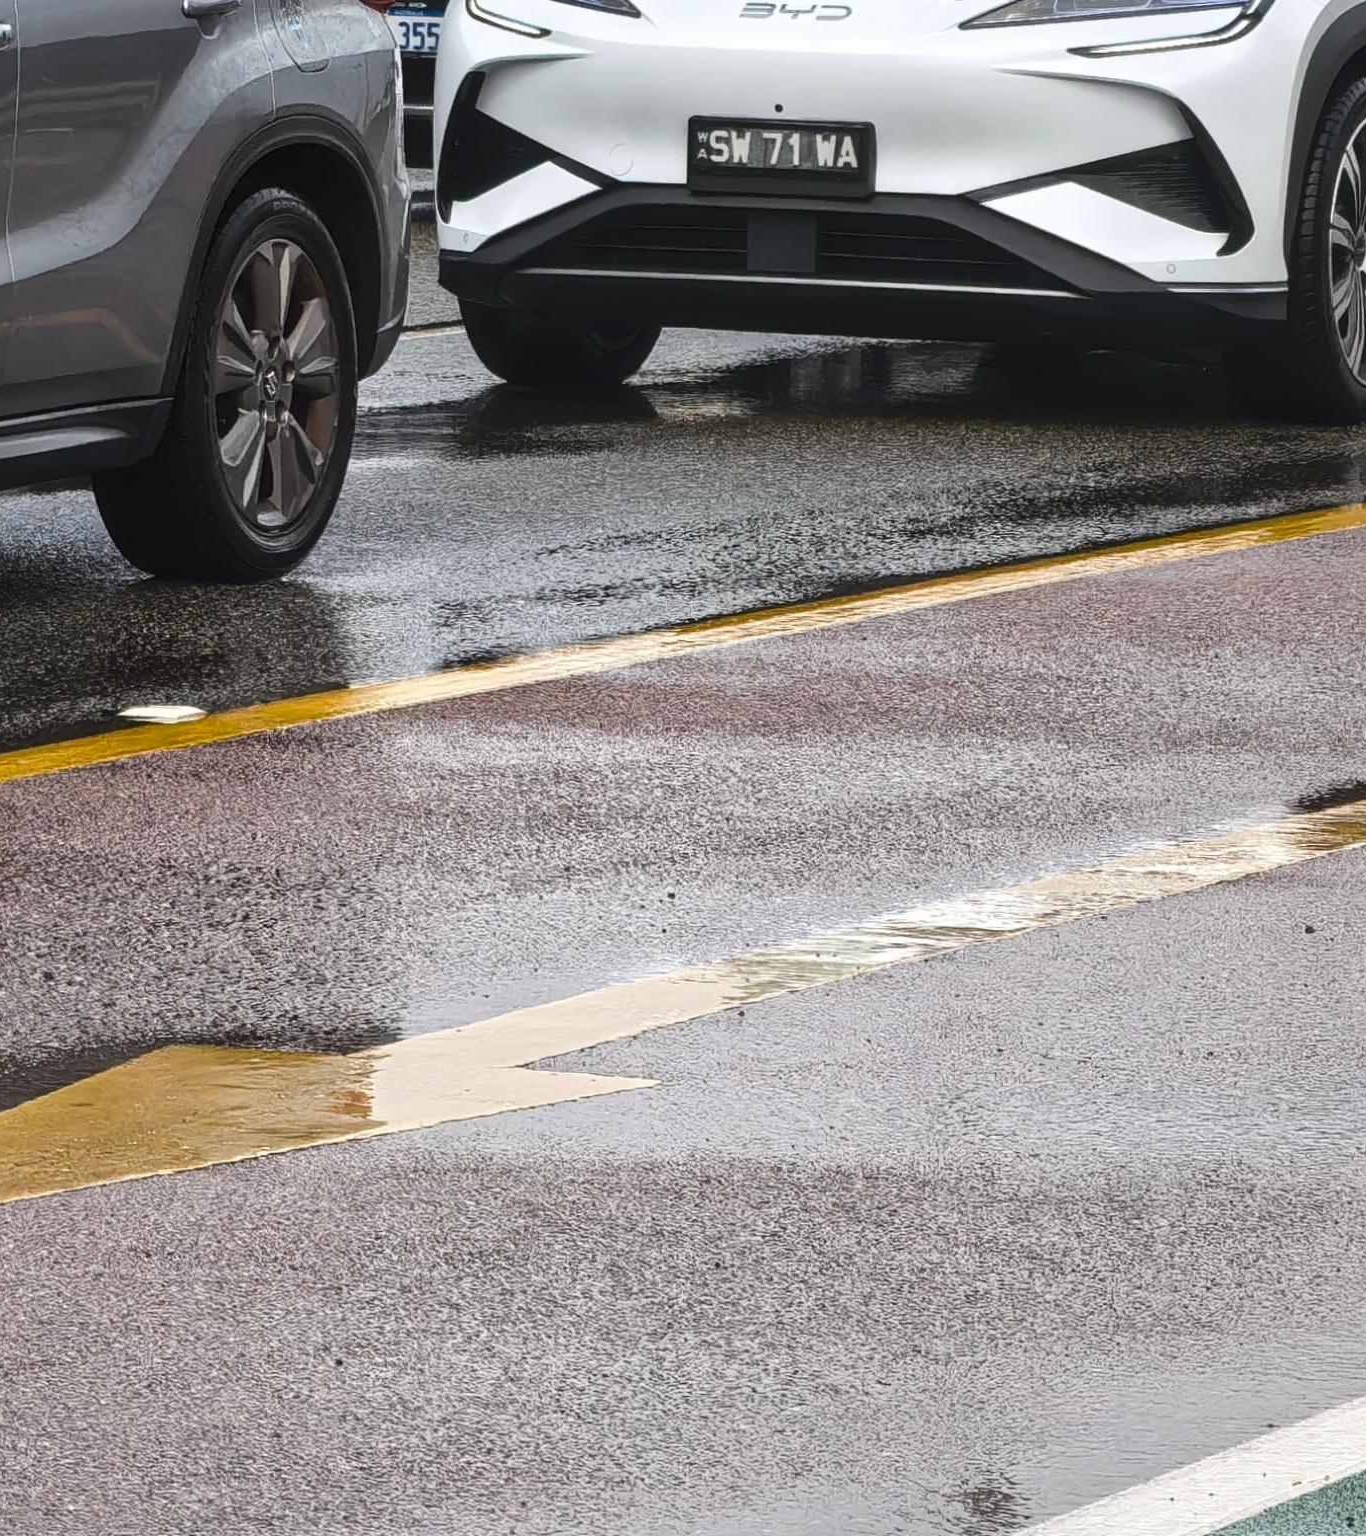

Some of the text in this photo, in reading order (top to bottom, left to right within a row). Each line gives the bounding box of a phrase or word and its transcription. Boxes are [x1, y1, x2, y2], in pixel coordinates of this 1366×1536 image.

[738, 2, 853, 21] BYD
[709, 129, 859, 169] SW 71 WA
